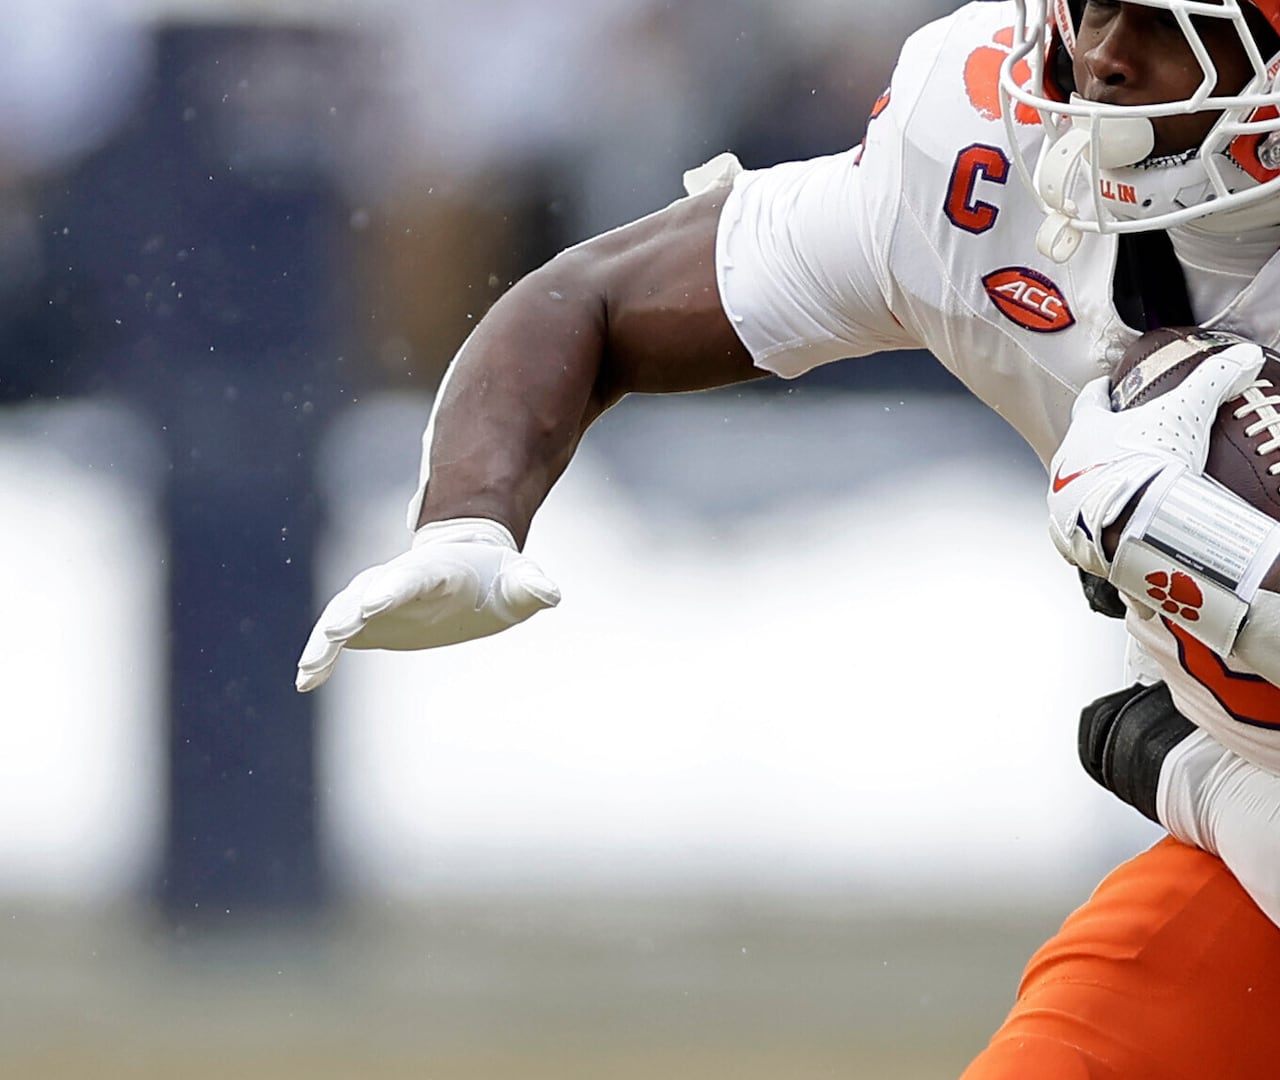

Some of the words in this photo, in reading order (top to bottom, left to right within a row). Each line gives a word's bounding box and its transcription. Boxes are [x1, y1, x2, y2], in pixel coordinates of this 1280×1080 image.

[943, 143, 1011, 235] C
[1117, 182, 1137, 204] IN
[995, 280, 1063, 319] ACC
